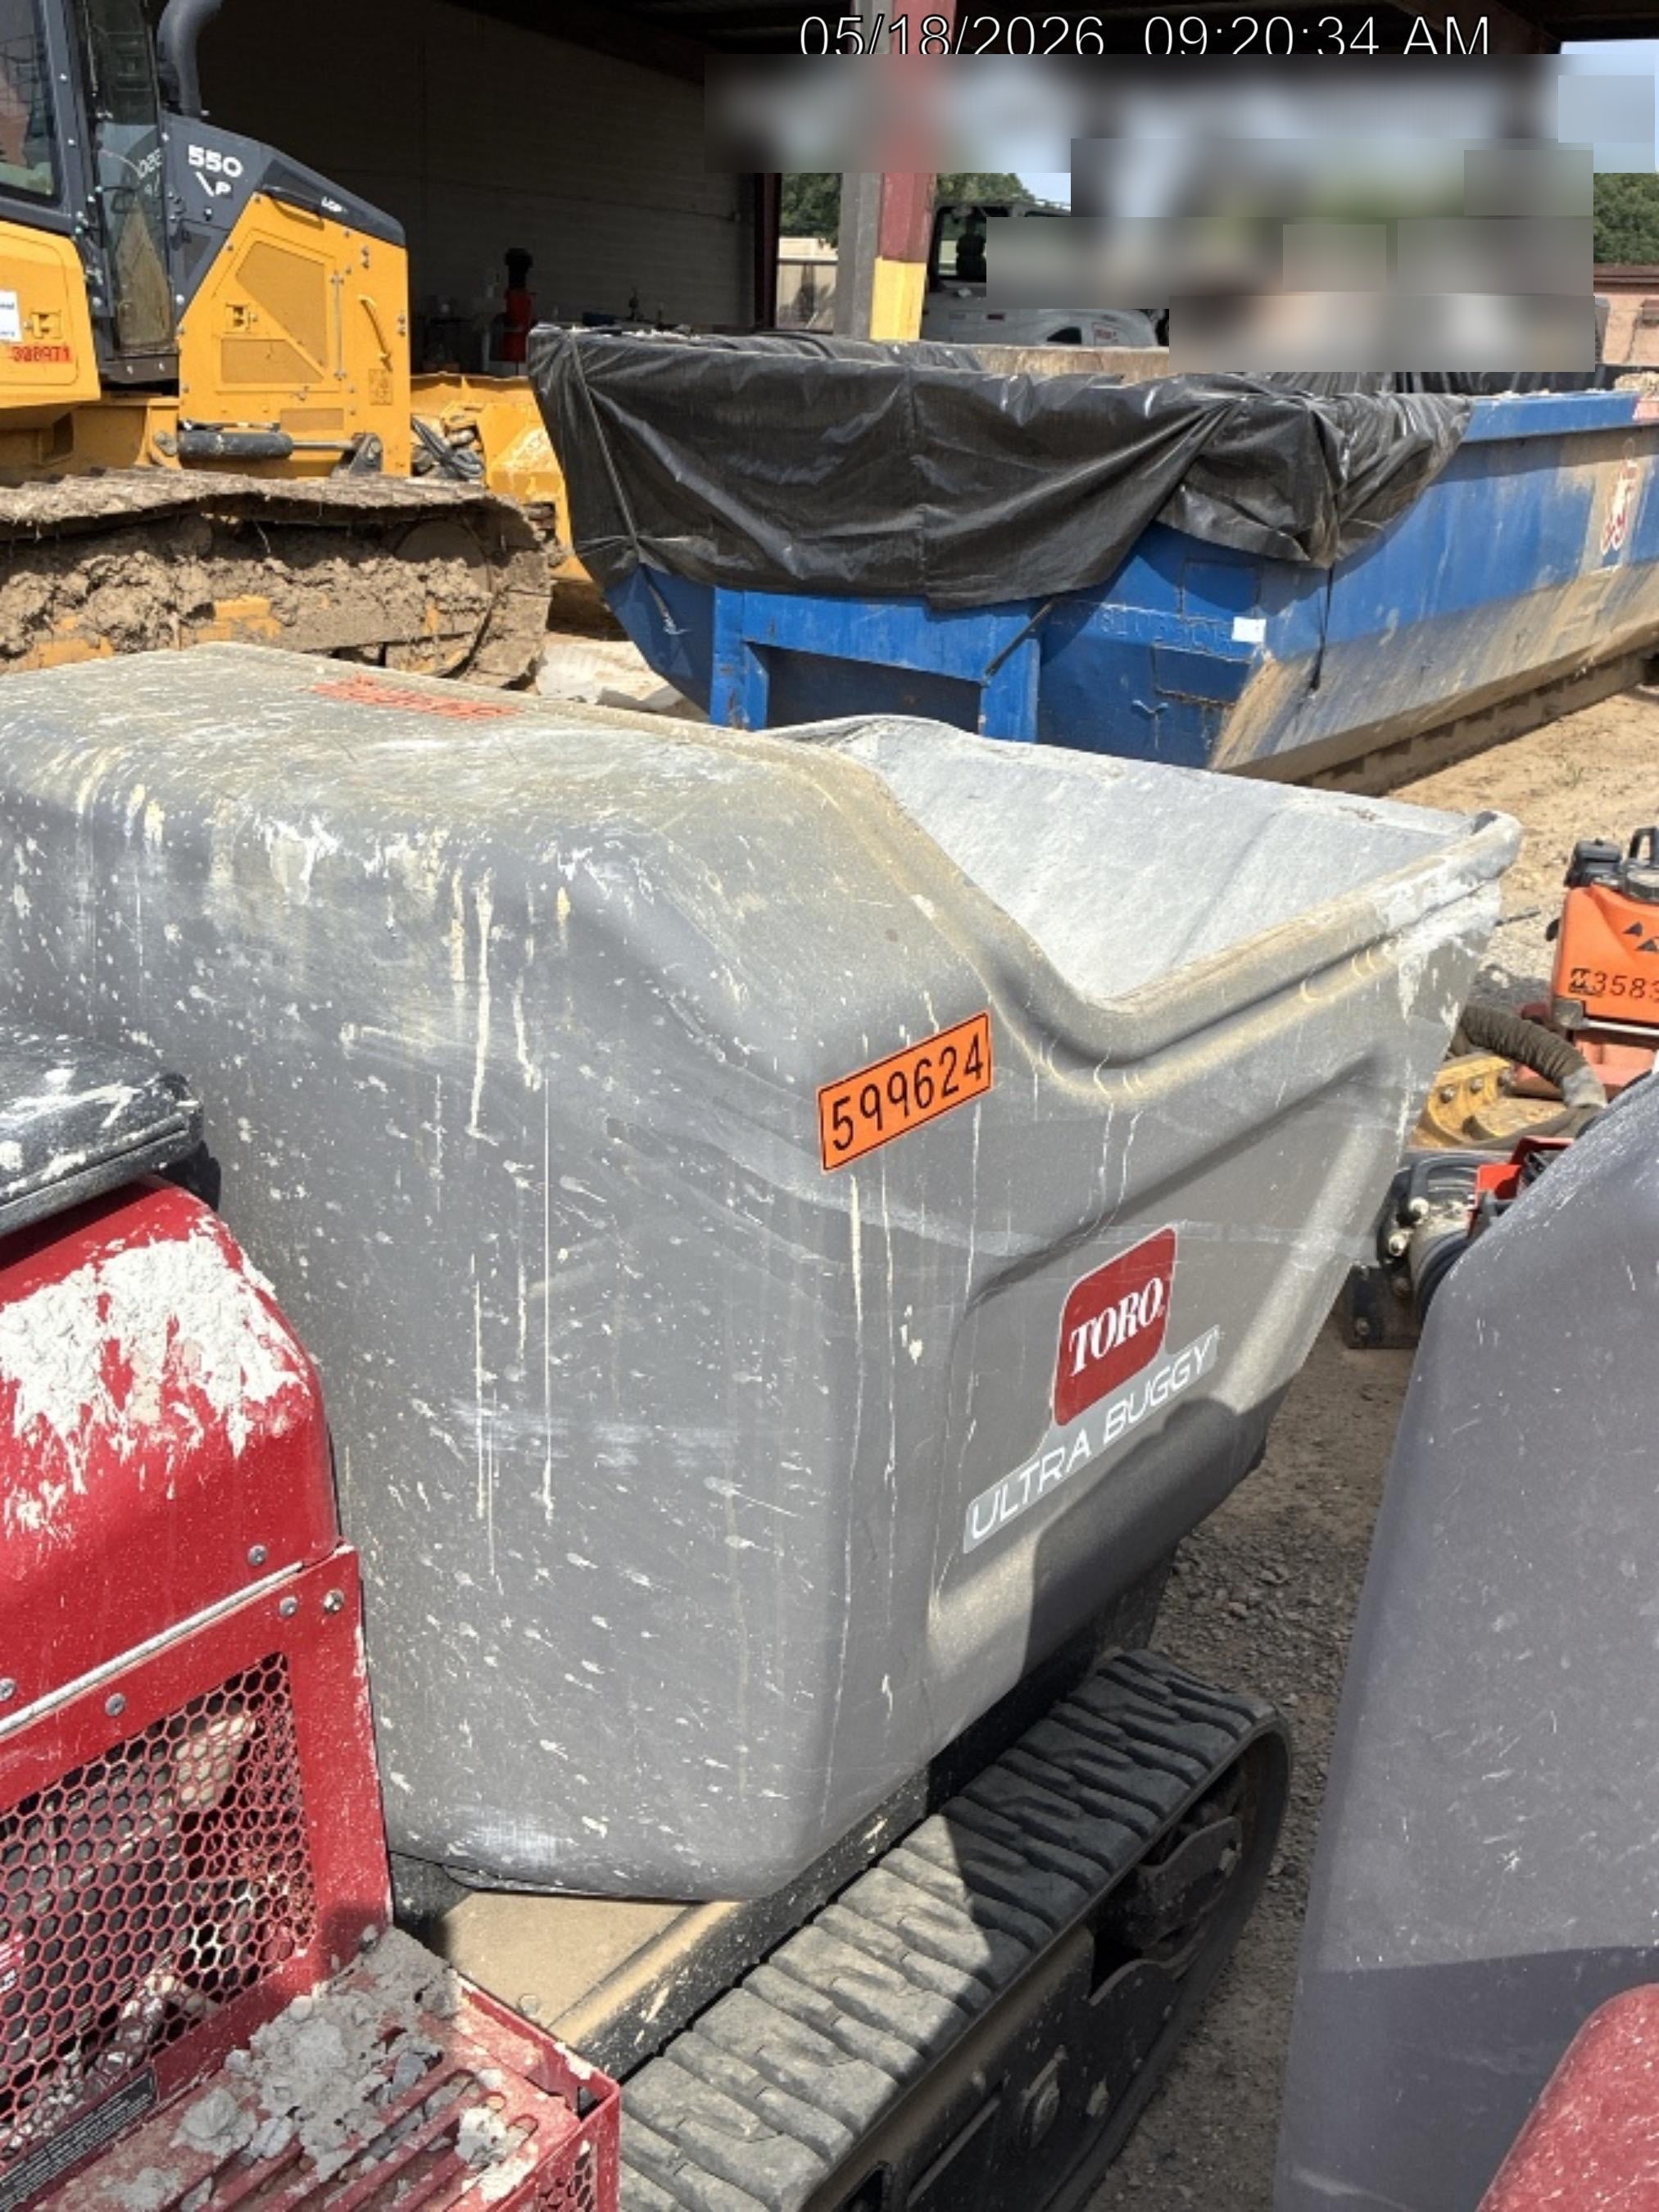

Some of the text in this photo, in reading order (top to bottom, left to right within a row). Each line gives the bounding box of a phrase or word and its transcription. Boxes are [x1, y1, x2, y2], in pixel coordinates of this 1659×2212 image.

[188, 143, 244, 178] 550
[832, 1032, 985, 1152] 599624
[1067, 1276, 1164, 1378] TORO
[971, 1324, 1219, 1540] ULTRA BUGGY
